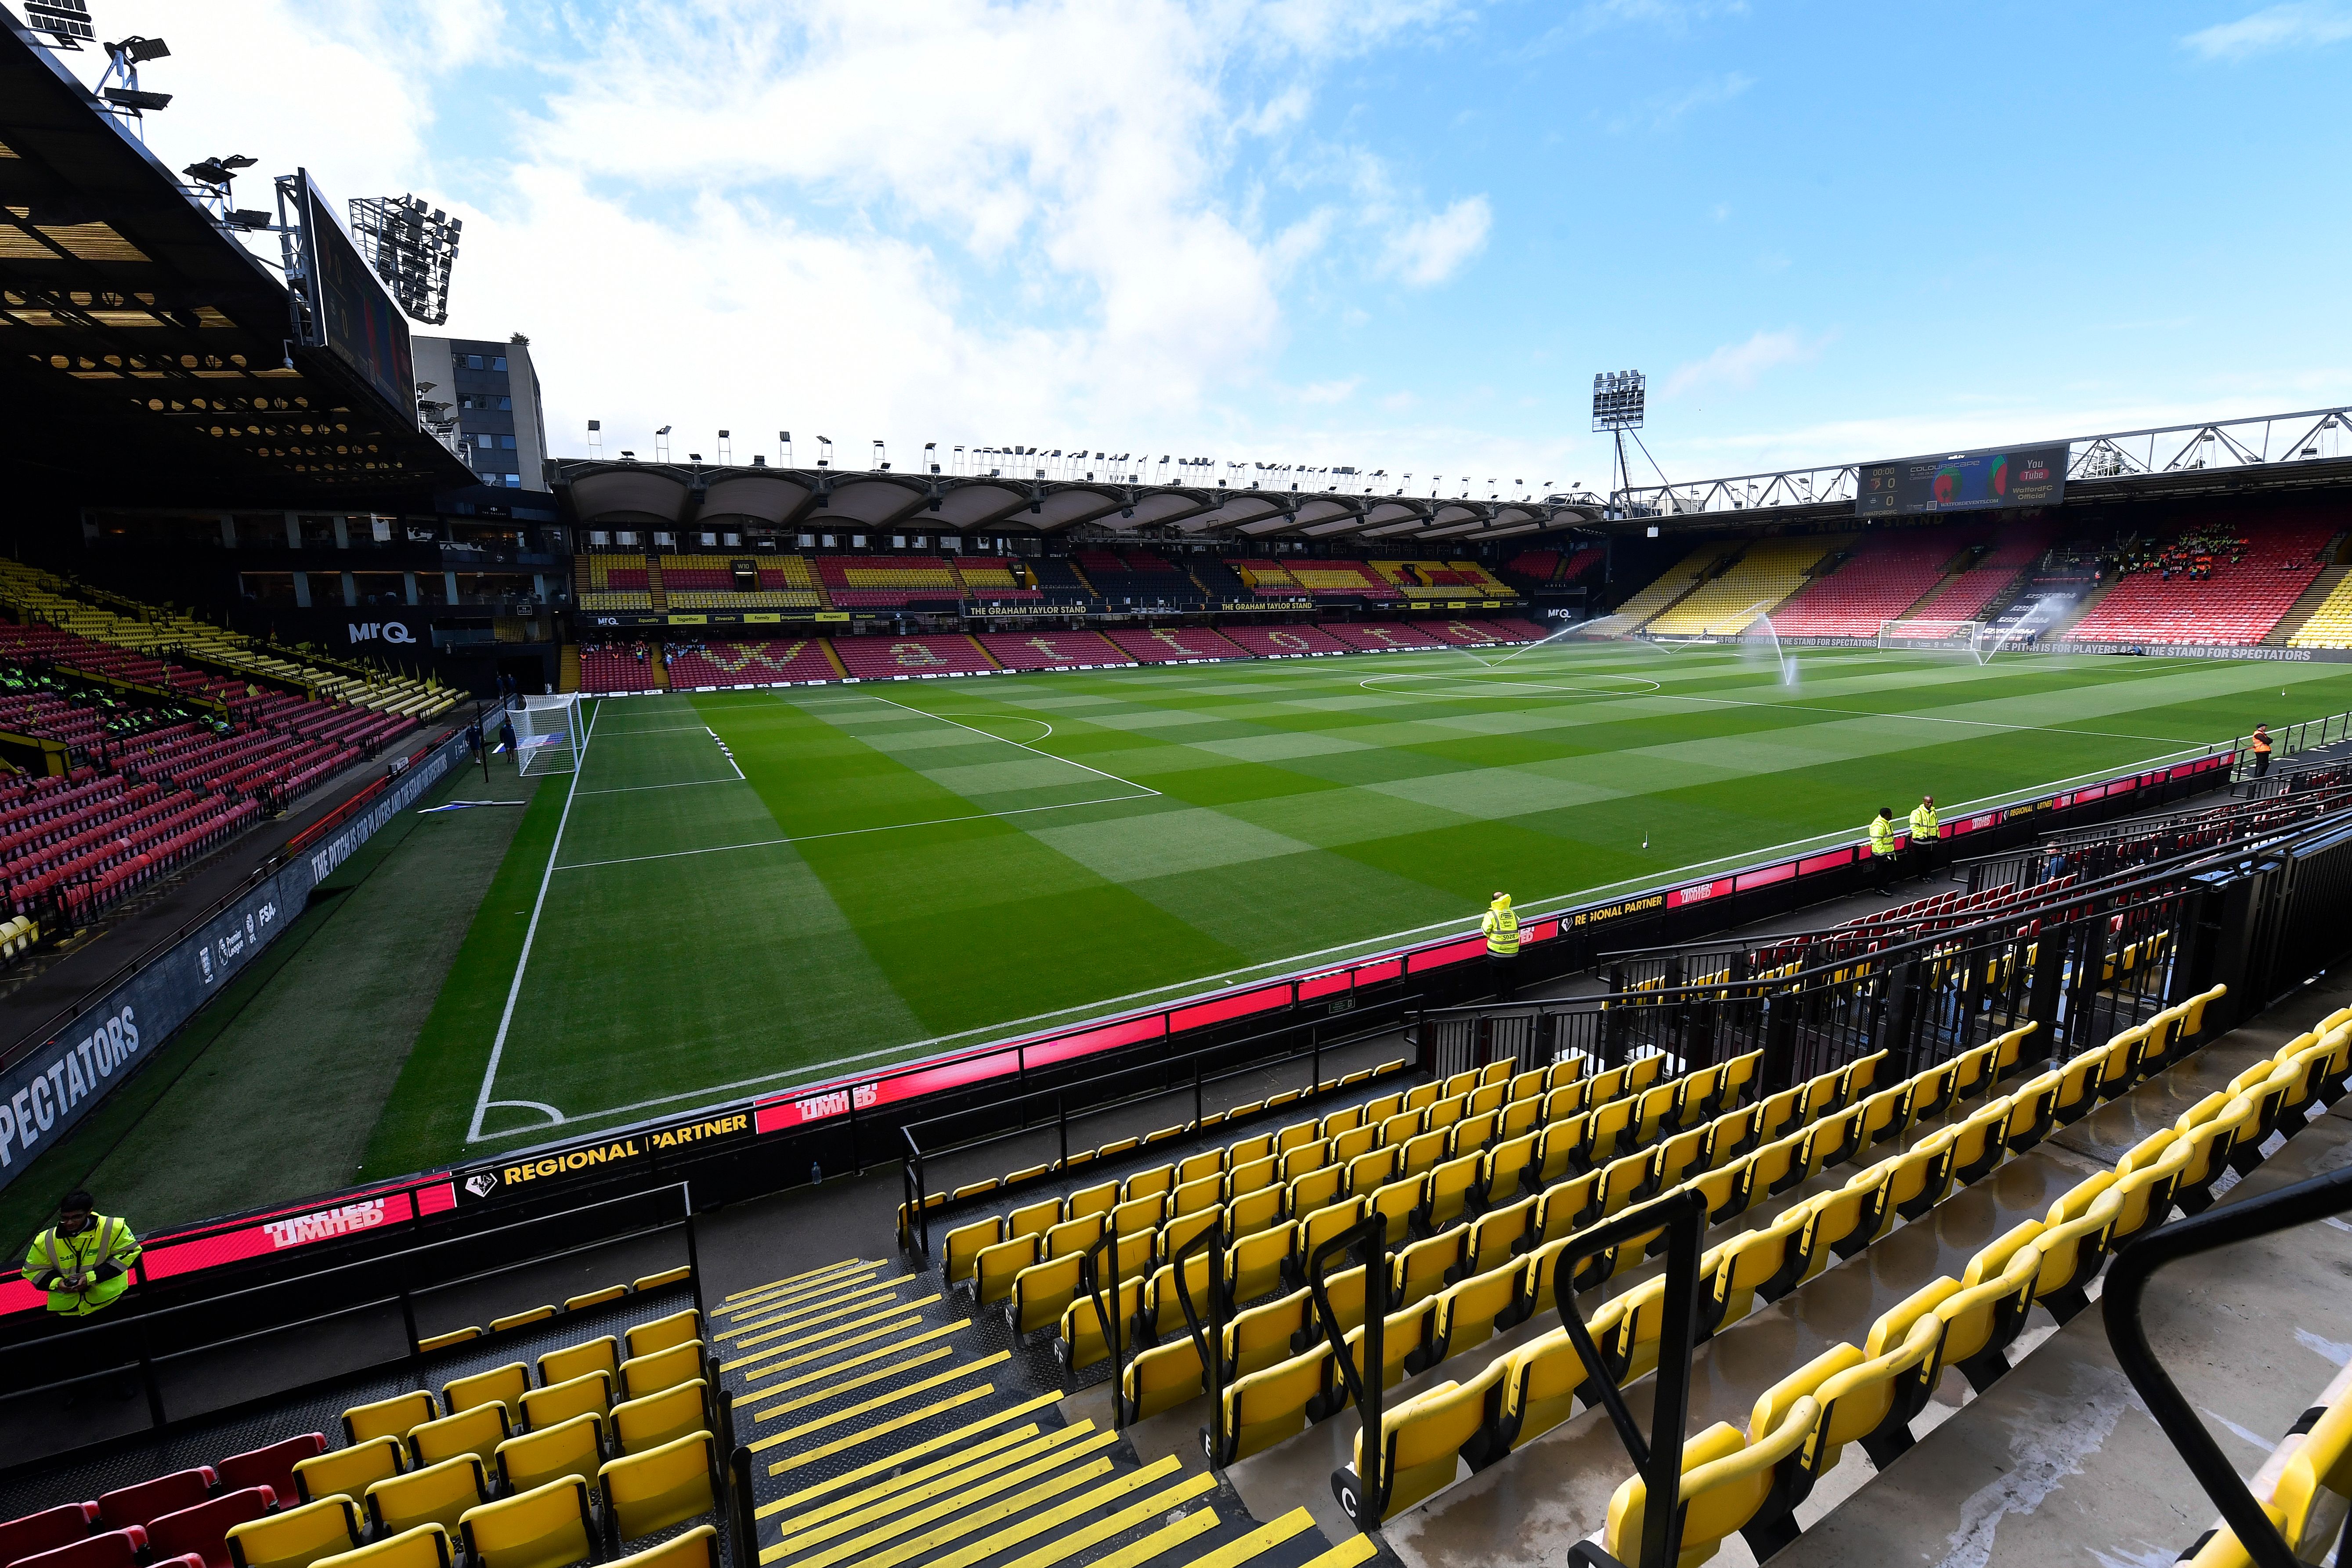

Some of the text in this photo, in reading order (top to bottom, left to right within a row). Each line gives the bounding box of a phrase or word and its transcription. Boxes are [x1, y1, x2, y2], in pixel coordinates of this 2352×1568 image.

[1872, 467, 1895, 476] 00:00
[2027, 459, 2043, 469] You
[1887, 477, 1895, 488] 0
[2024, 471, 2043, 480] Tube
[2012, 485, 2053, 493] WatfordFC
[1886, 495, 1894, 506] 0
[1548, 608, 1572, 618] MrQ
[349, 621, 416, 644] MrQ
[1831, 639, 1877, 647] SPECTATORS
[2041, 643, 2050, 652] IS
[2052, 643, 2071, 653] FOR
[2072, 644, 2117, 654] PLAYERS
[2145, 646, 2166, 656] THE
[2167, 647, 2204, 657] STAND
[2207, 648, 2230, 658] FOR
[2231, 648, 2311, 661] SPECTATORS
[2009, 804, 2033, 817] REGIONAL
[2037, 799, 2053, 810] ARTNER
[311, 849, 329, 885] THE
[328, 832, 351, 872] PITCH
[350, 827, 358, 853] IS
[356, 817, 369, 847] FOR
[368, 798, 392, 836] PLAYERS
[391, 790, 401, 817] AND
[400, 782, 410, 808] THE
[409, 773, 422, 801] STAND
[1625, 896, 1662, 914] PARTNER
[225, 930, 242, 947] Premier
[228, 939, 243, 957] League
[504, 1140, 639, 1185] REGIONAL
[272, 1209, 384, 1248] LIMITED
